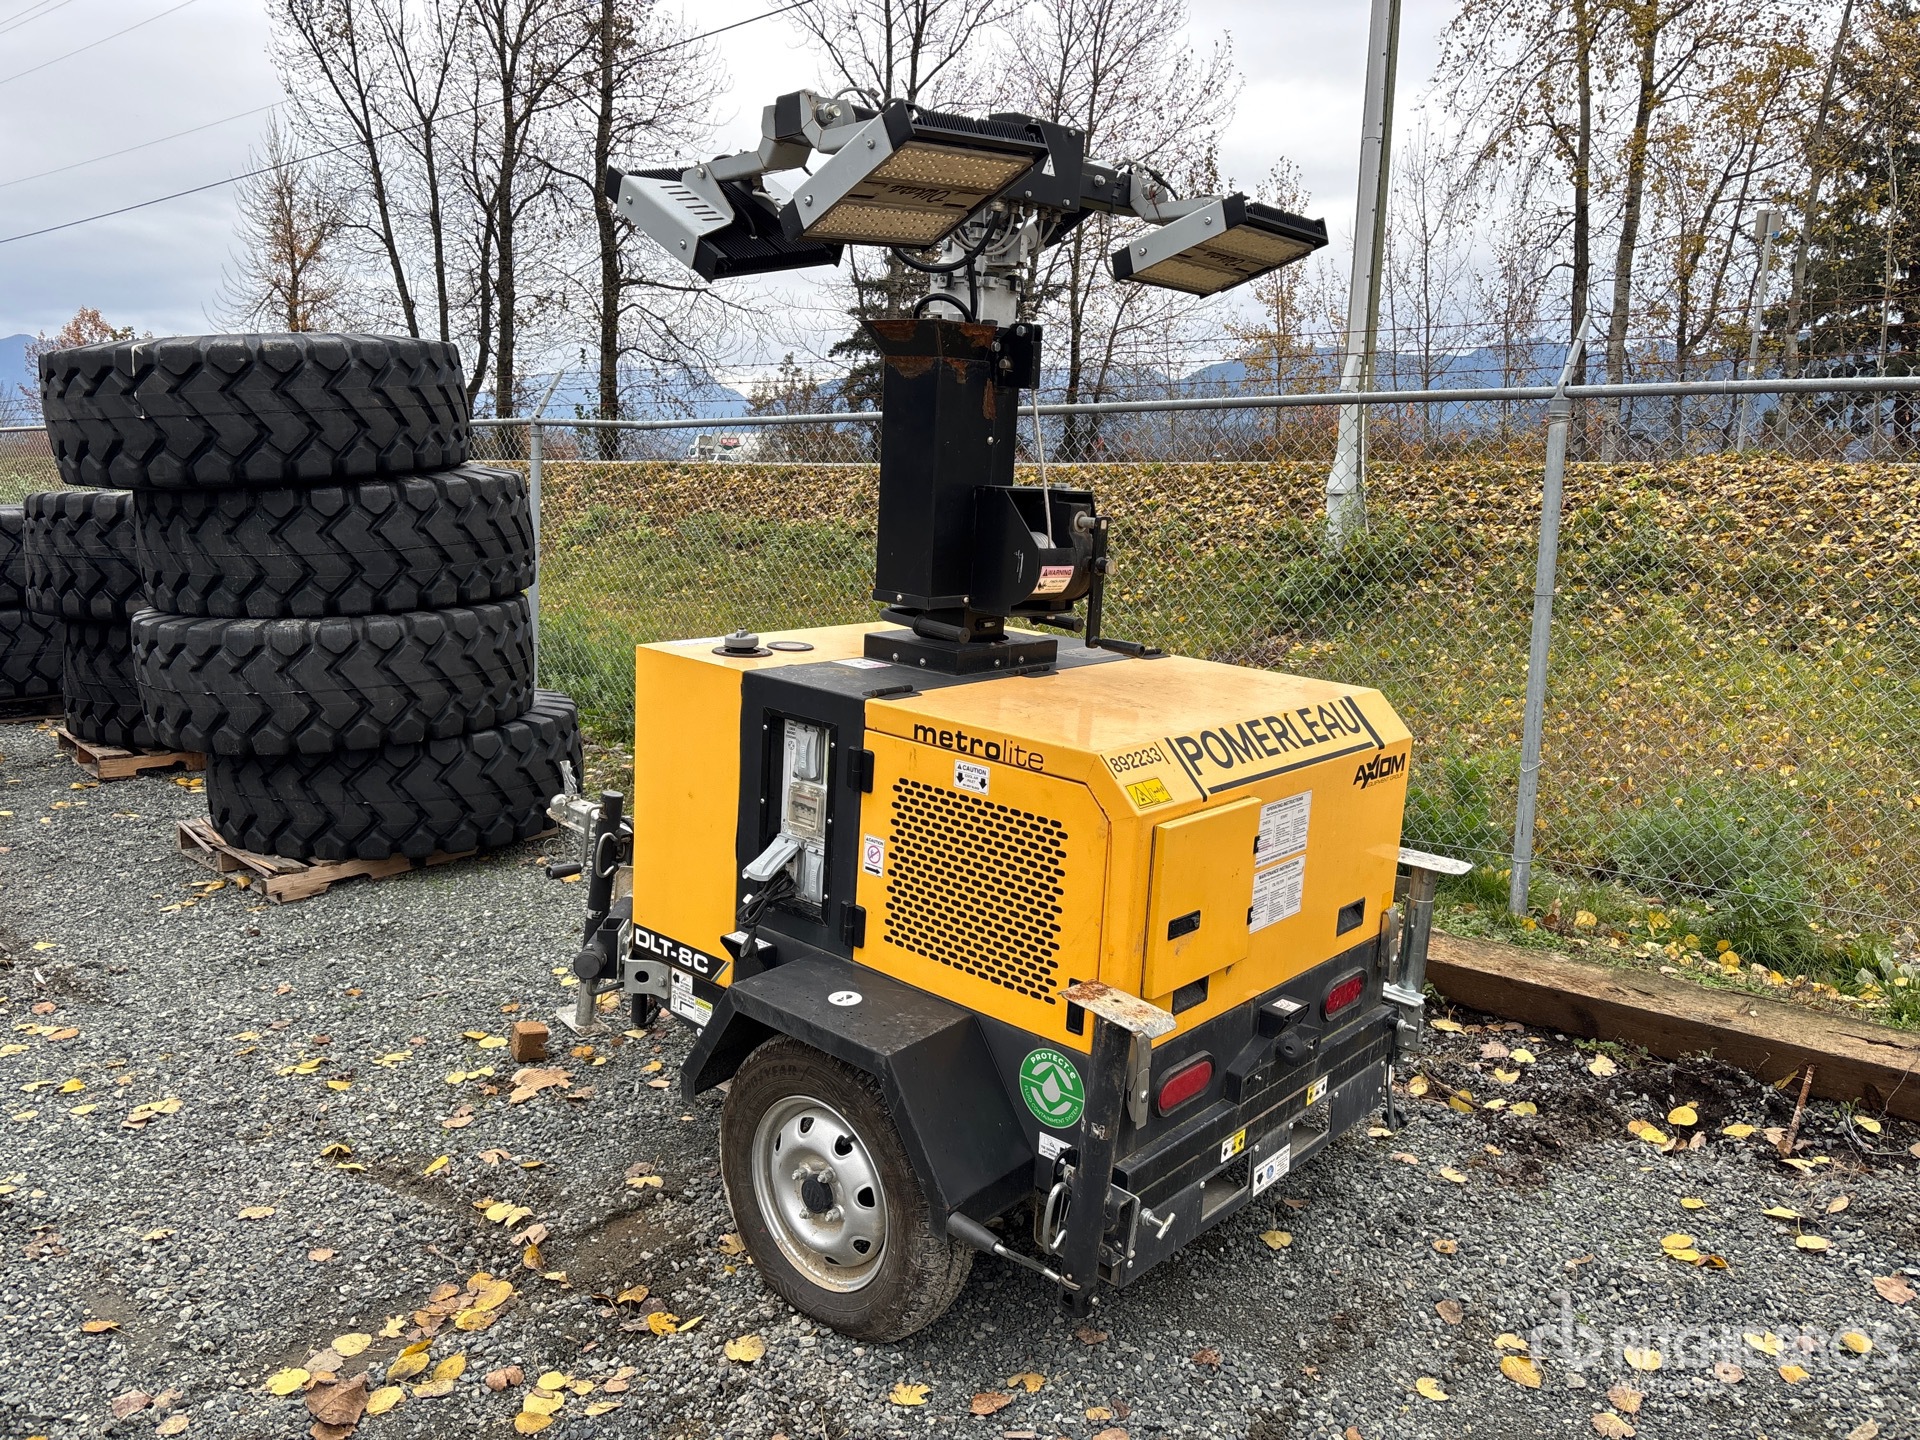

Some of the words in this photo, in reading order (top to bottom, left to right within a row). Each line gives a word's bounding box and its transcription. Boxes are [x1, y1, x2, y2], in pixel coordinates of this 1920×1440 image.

[913, 723, 1044, 771] metrolite
[1174, 699, 1361, 776] POMERLEAU
[962, 765, 987, 775] CAUTION
[1109, 747, 1162, 773] 892233
[635, 928, 709, 974] DLT-8C
[1031, 1103, 1065, 1124] CONTAINMENT
[1065, 1106, 1079, 1122] SYSTEM
